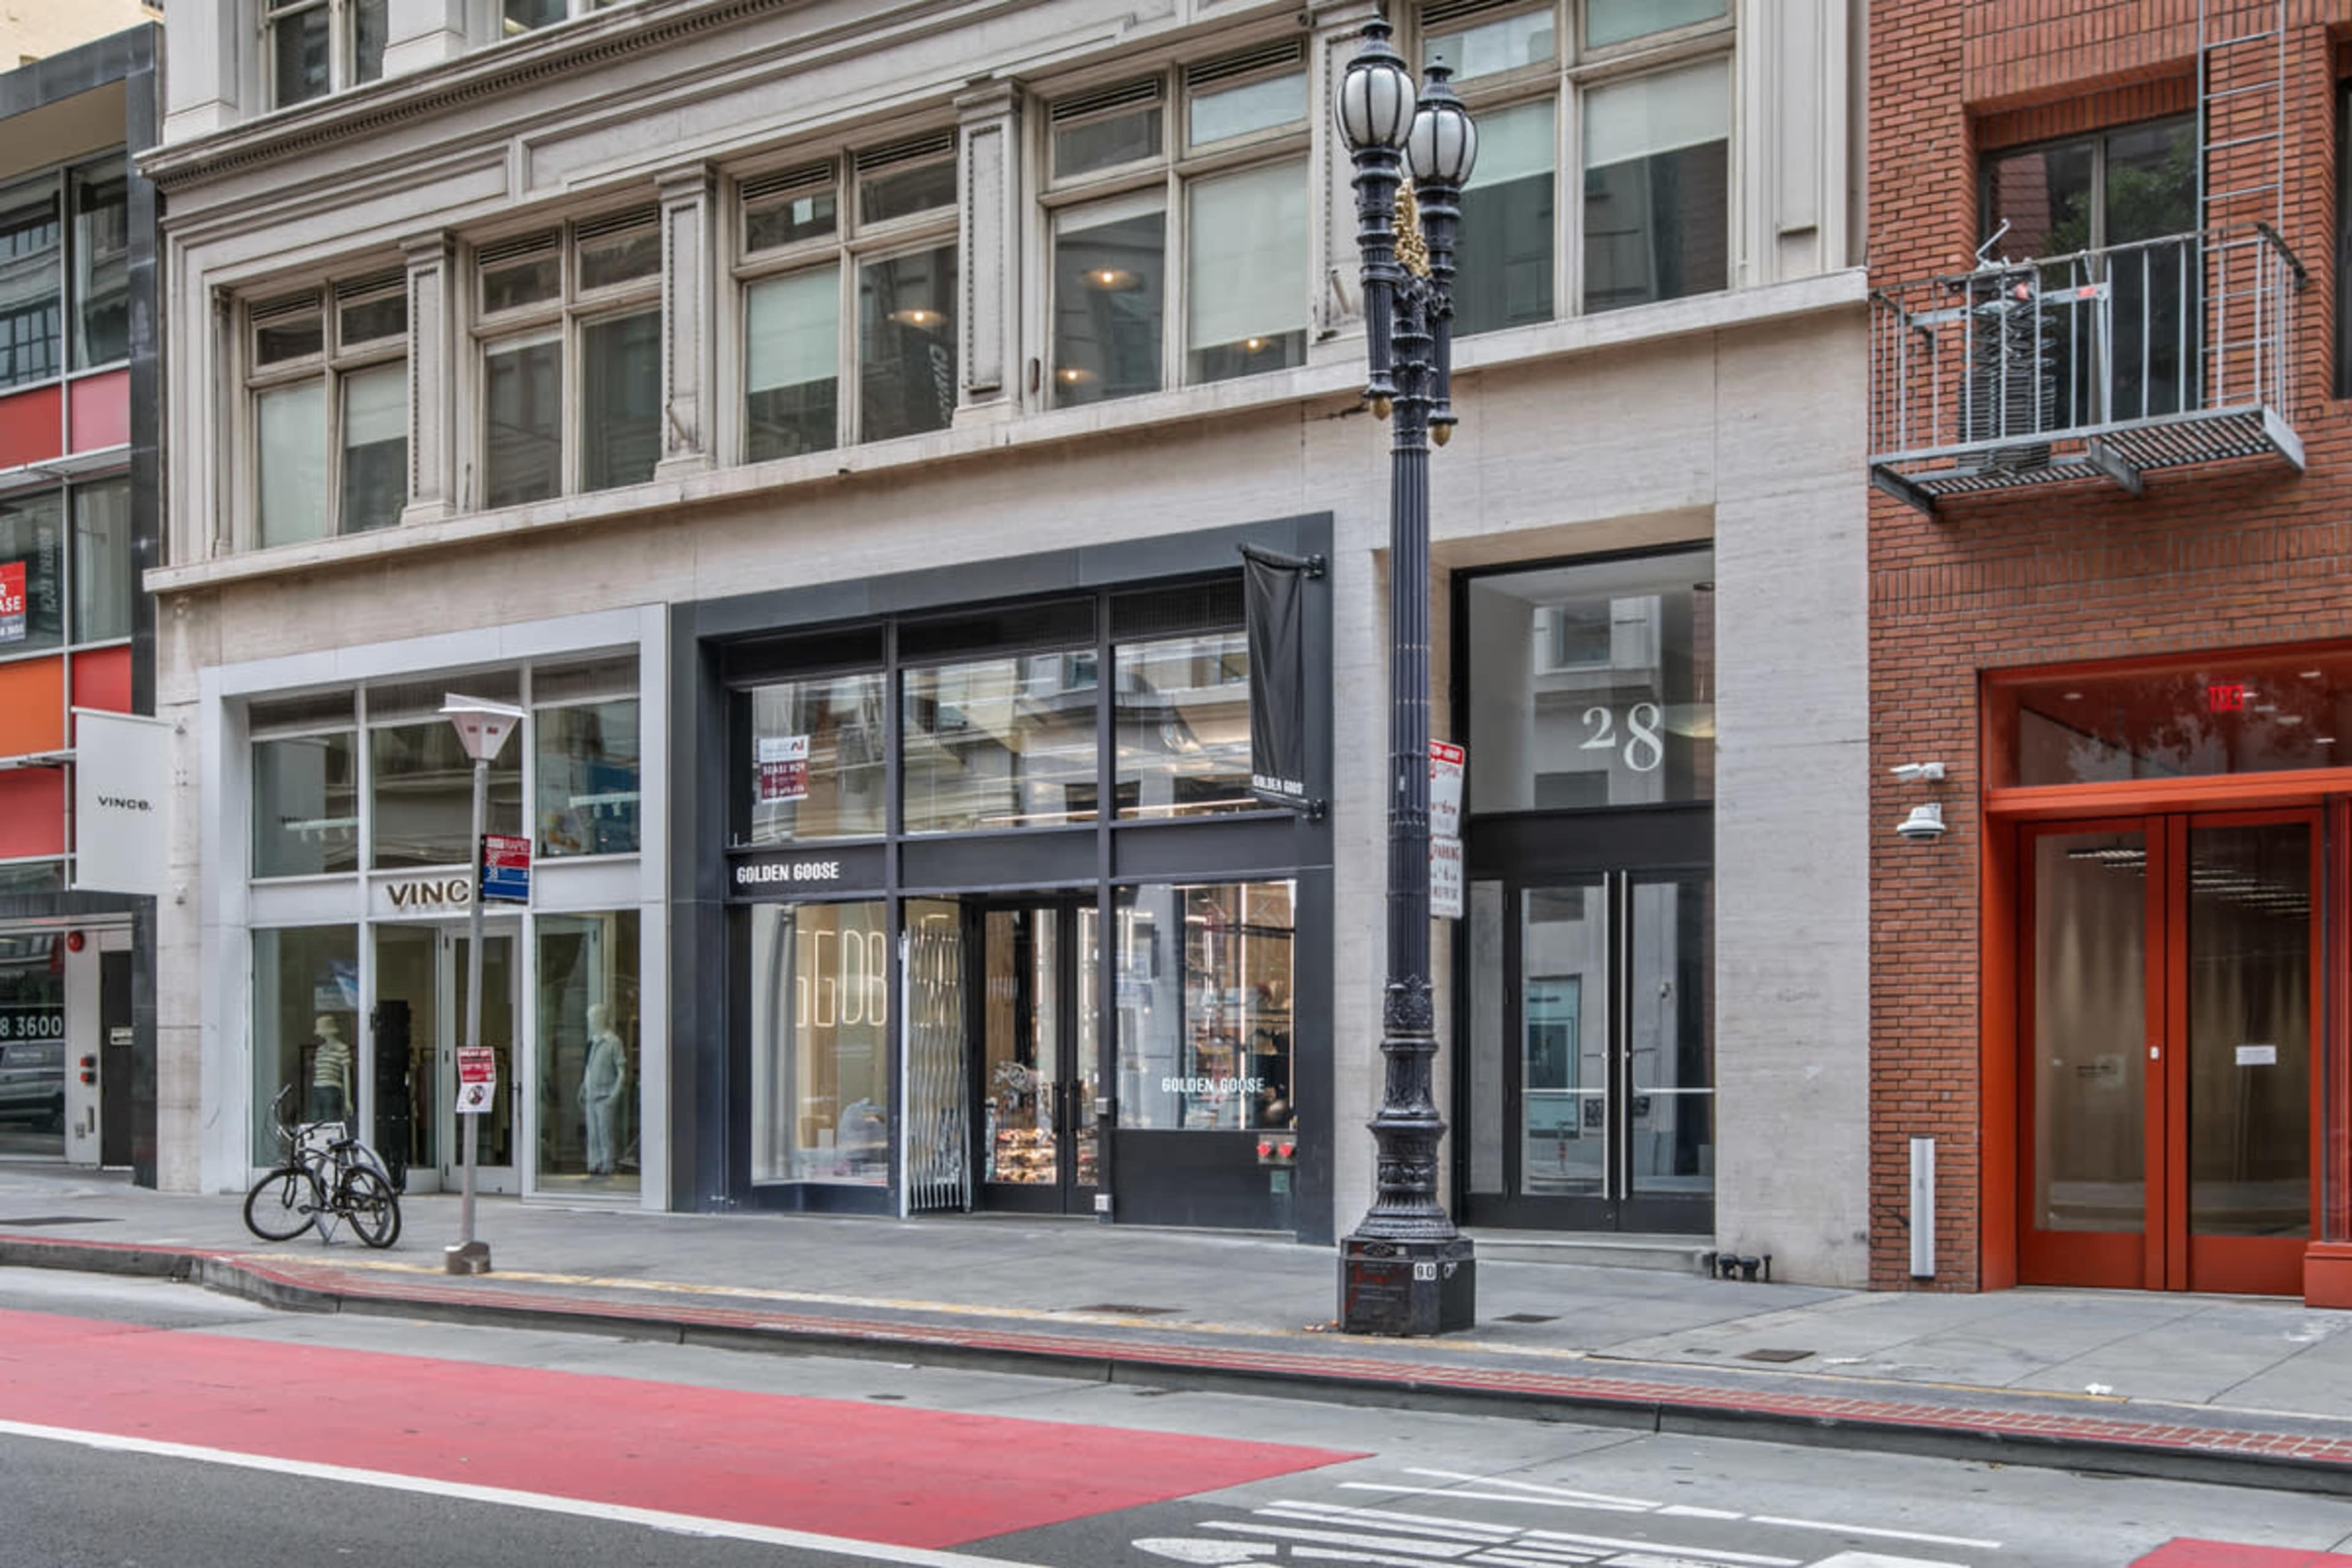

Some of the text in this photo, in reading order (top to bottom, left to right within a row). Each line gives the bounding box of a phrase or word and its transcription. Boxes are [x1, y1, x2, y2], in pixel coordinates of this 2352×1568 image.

[1579, 703, 1663, 771] 28
[736, 862, 839, 883] GOLDEN GOOSE
[386, 879, 469, 906] VINC
[15, 1015, 62, 1037] 3600
[1161, 1077, 1265, 1093] GOLDEN GOOSE
